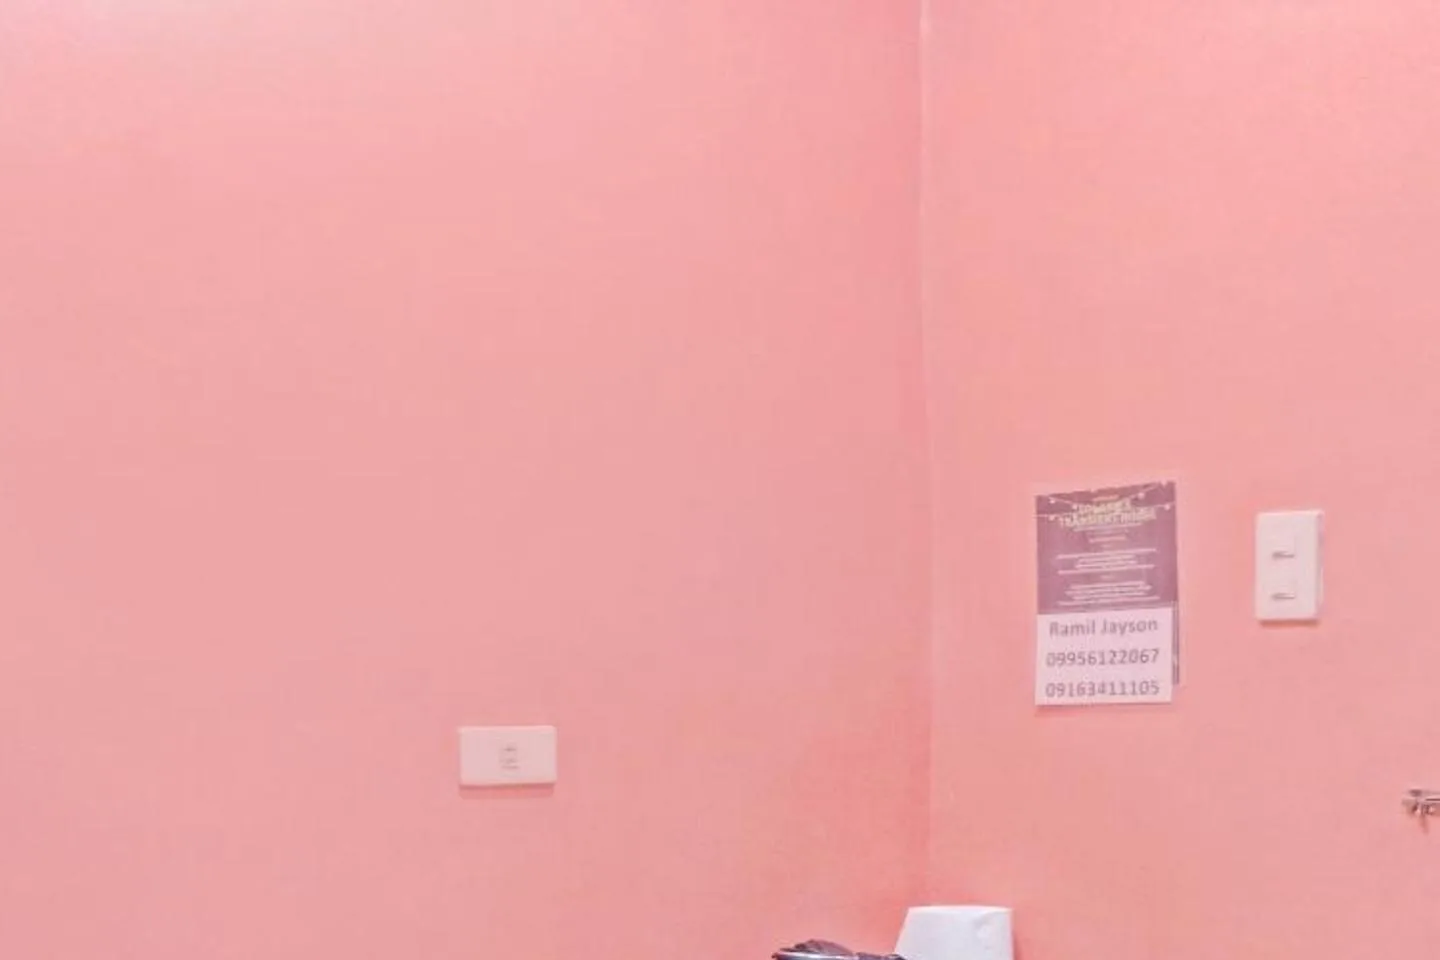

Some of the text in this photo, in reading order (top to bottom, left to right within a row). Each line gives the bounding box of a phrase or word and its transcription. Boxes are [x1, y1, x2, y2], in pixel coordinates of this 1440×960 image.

[1049, 618, 1159, 637] Ramil Jayson
[1045, 648, 1160, 668] 09956122067
[1045, 680, 1160, 698] 09163411105
